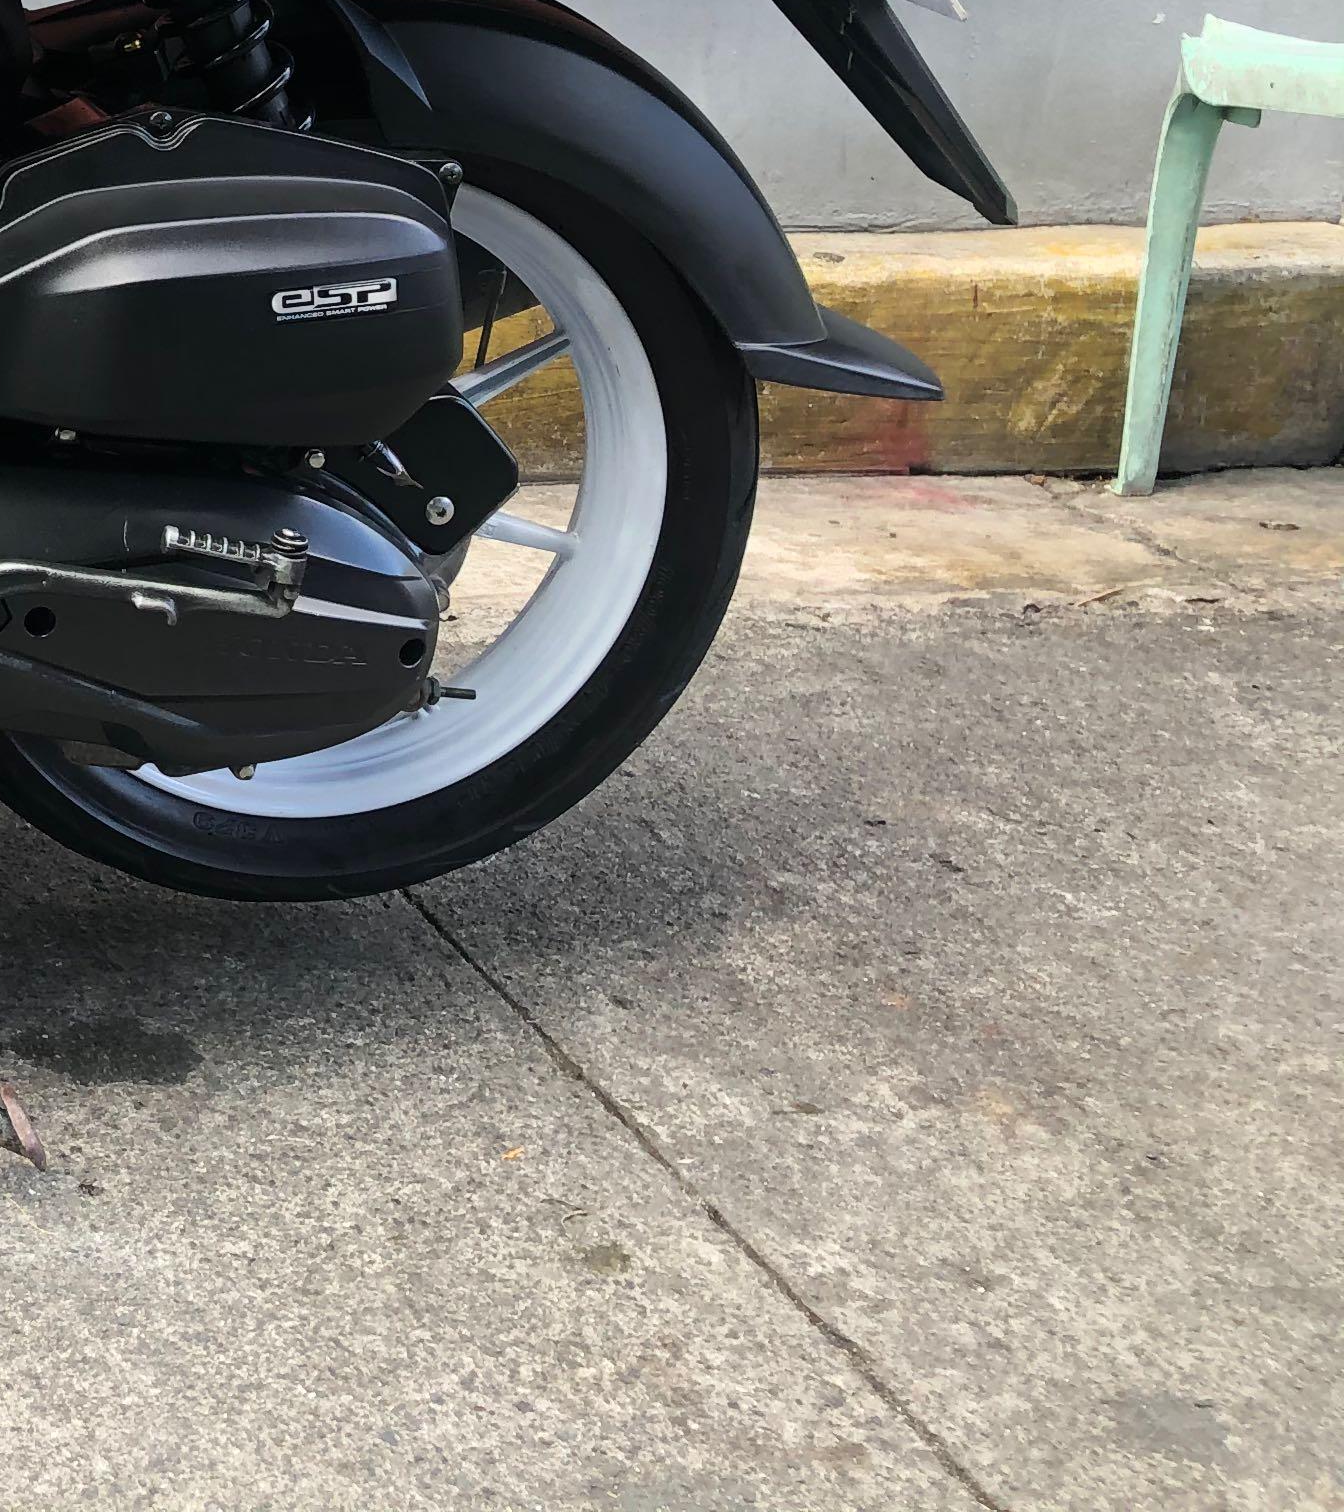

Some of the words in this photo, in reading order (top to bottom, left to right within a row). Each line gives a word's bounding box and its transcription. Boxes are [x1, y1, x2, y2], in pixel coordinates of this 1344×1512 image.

[276, 311, 324, 322] ENHANCED
[326, 307, 356, 317] SMART
[357, 303, 388, 313] POWER
